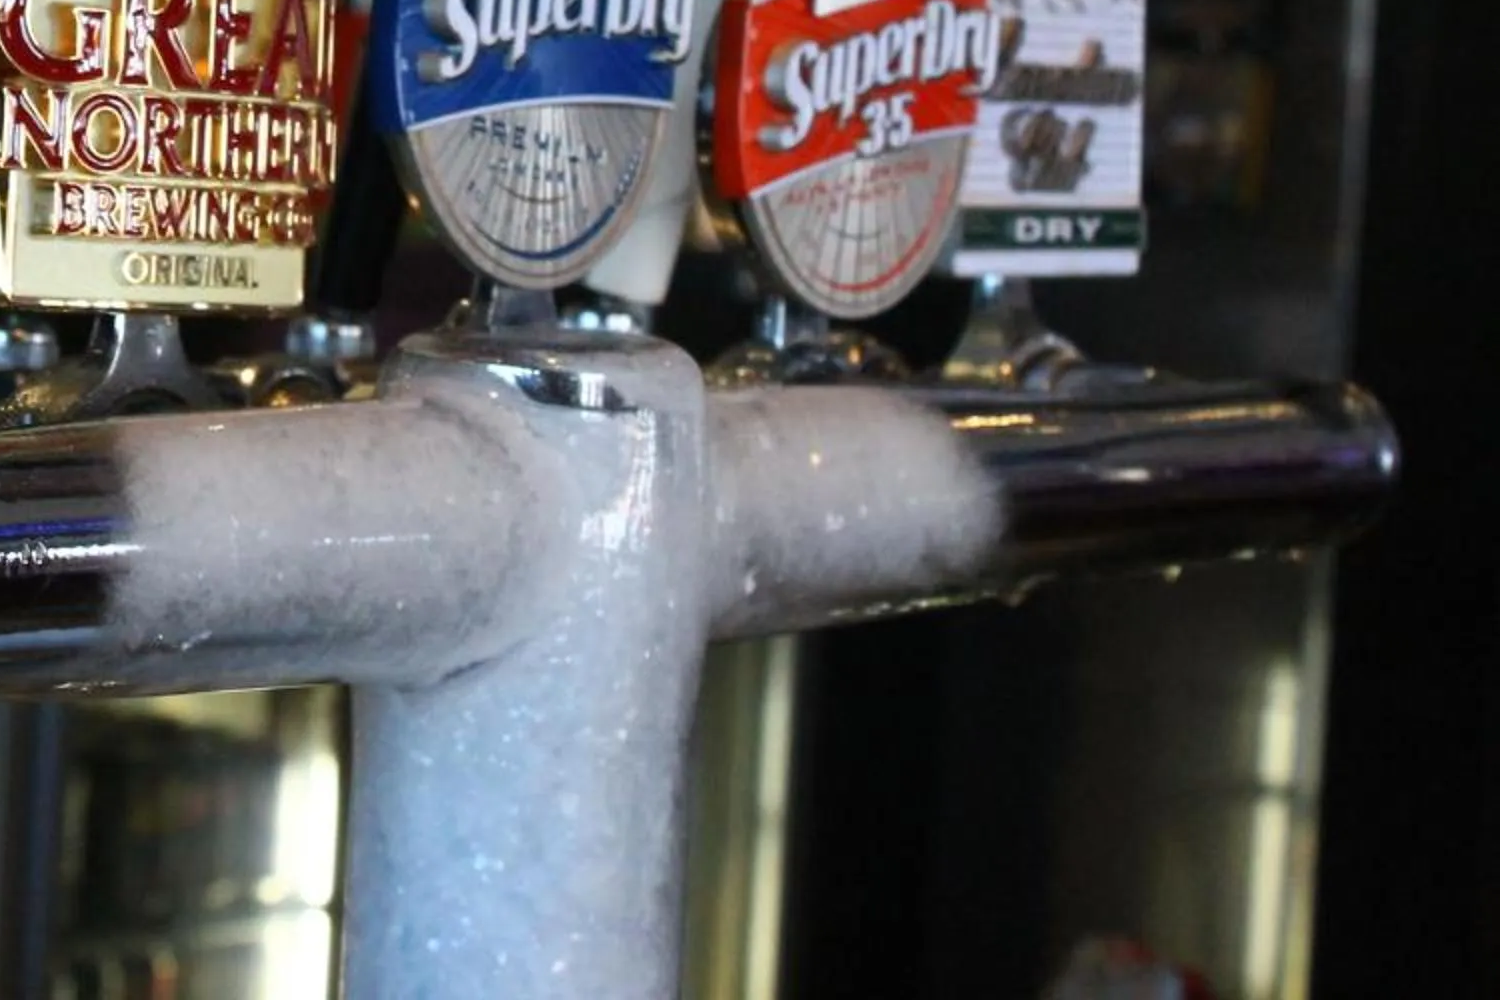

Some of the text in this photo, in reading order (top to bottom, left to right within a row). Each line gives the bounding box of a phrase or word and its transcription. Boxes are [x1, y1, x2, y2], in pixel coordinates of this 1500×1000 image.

[0, 86, 338, 184] NORTHERN
[51, 180, 260, 241] BREWING
[1013, 214, 1102, 243] DRY
